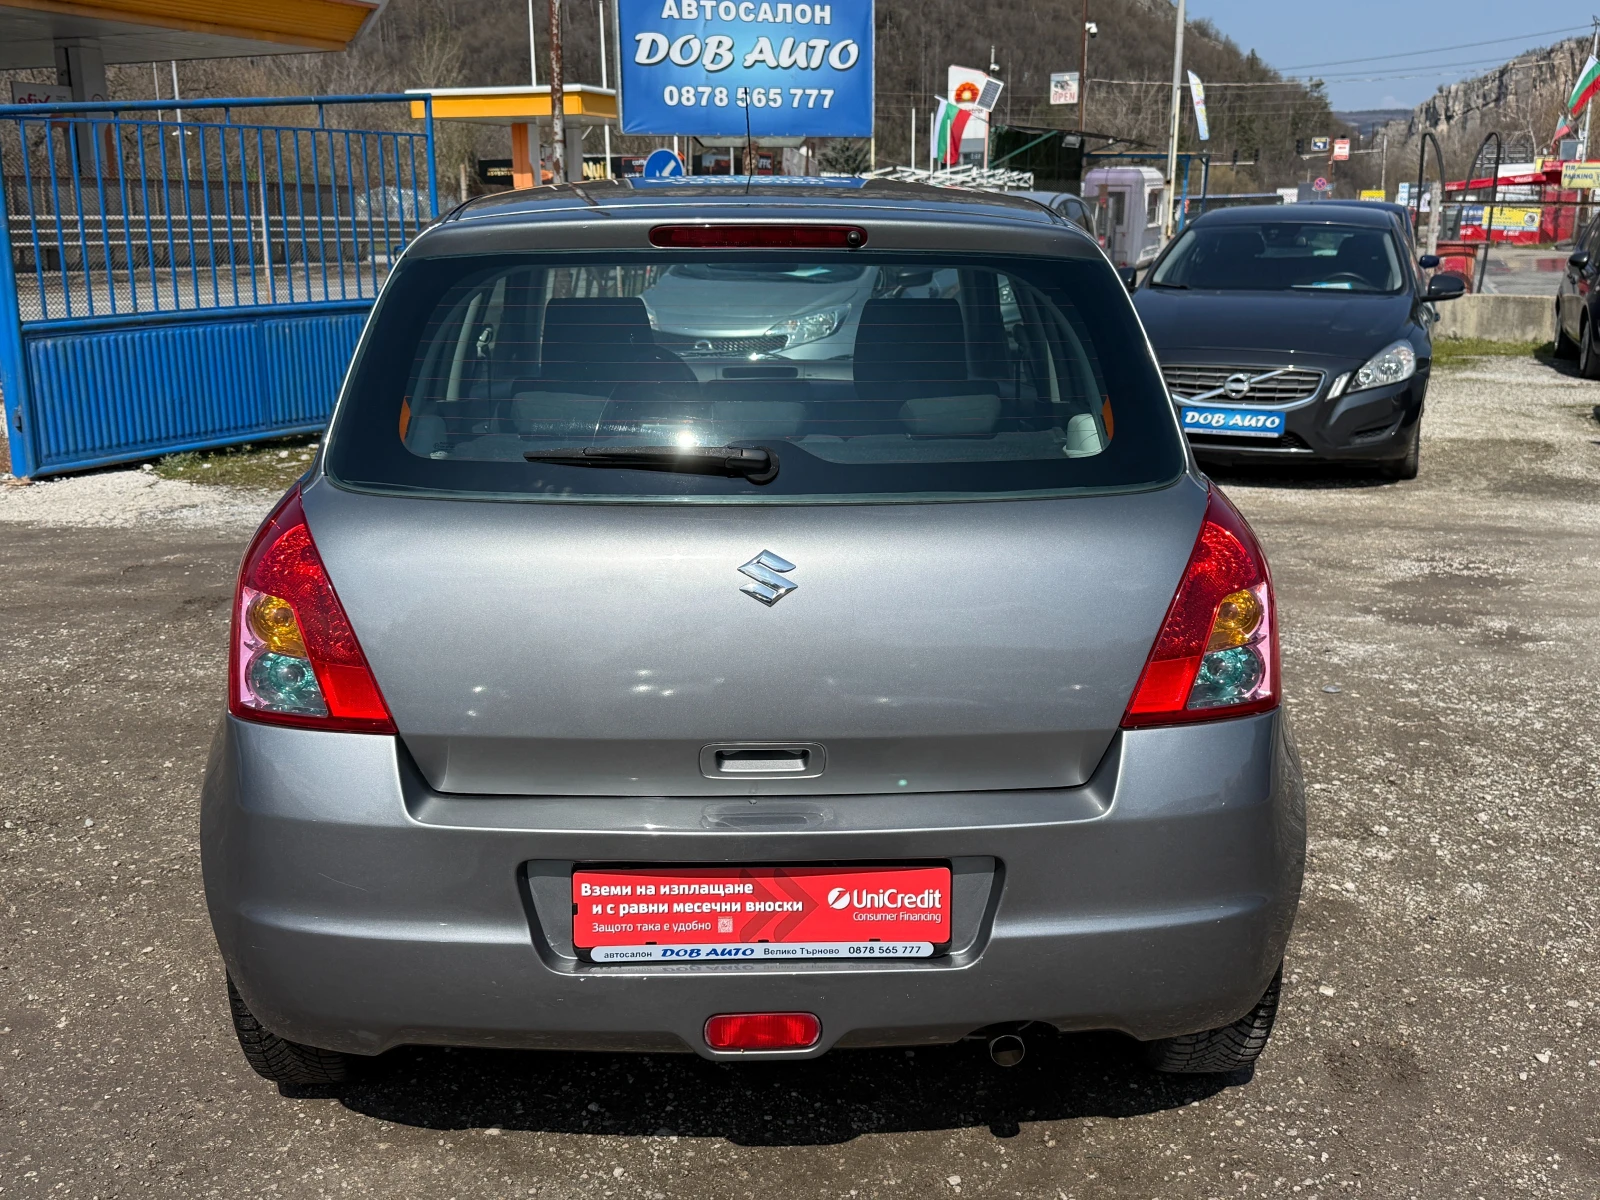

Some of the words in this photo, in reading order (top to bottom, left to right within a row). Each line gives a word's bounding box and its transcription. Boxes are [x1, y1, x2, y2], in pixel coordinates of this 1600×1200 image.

[661, 0, 831, 25] АВТОСАЛОН
[634, 32, 735, 72] DOB
[743, 36, 859, 70] AUTO
[663, 86, 729, 107] 0878
[736, 87, 782, 108] 565
[789, 88, 835, 109] 777
[1052, 92, 1076, 102] OPEN
[1184, 411, 1225, 427] DOB
[1228, 414, 1280, 429] AUTO
[581, 883, 632, 897] Вземи
[636, 884, 656, 896] на
[659, 883, 754, 897] изплащане
[853, 889, 942, 909] UniCredit
[592, 904, 602, 915] и
[606, 903, 616, 914] с
[619, 902, 669, 917] равни
[672, 901, 741, 914] месечни
[745, 901, 803, 912] вноски
[853, 911, 897, 921] Consumer
[899, 911, 942, 923] Financing
[591, 922, 634, 933] Защото
[636, 922, 661, 931] така
[663, 923, 670, 931] е
[672, 920, 712, 932] удобно
[603, 951, 653, 959] автосалон
[661, 948, 701, 958] DOB
[705, 947, 755, 957] AUTO
[763, 947, 797, 955] Велико
[799, 947, 840, 956] Търново
[848, 946, 875, 954] 0878
[878, 946, 898, 954] 565
[901, 946, 922, 954] 777
